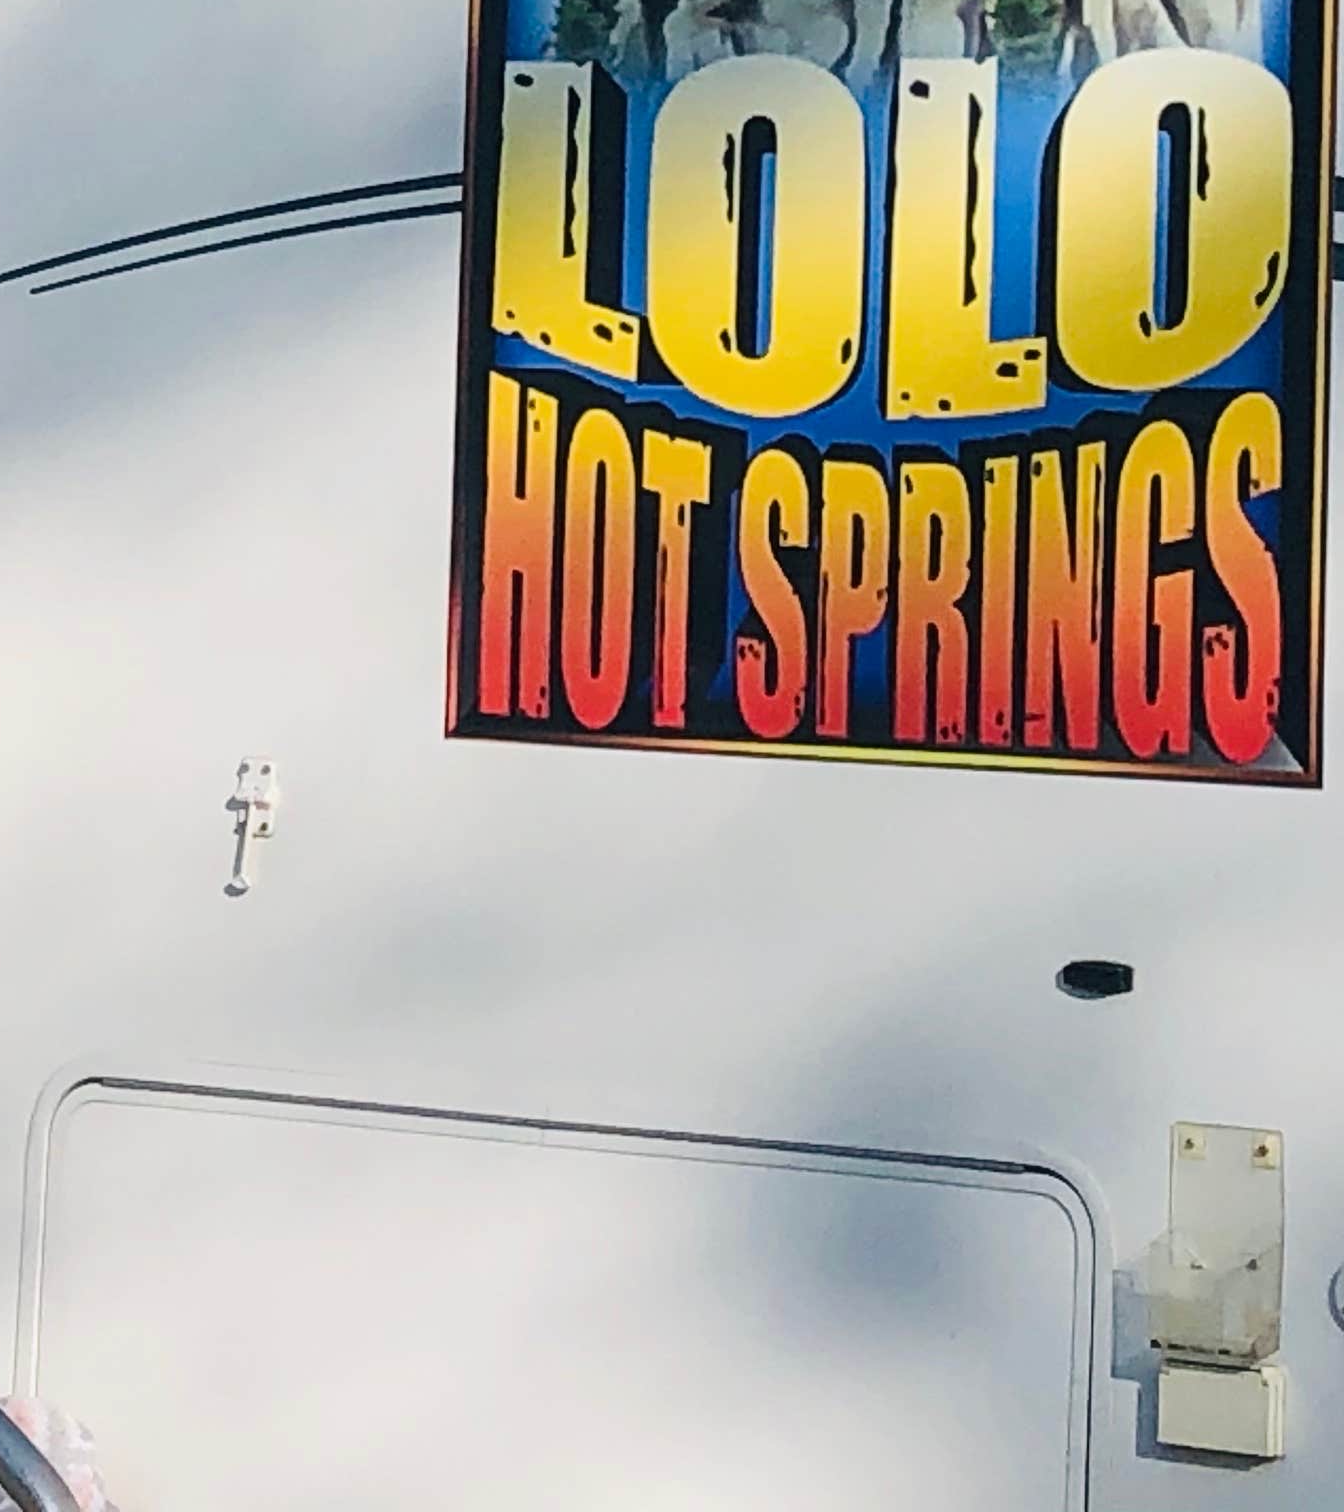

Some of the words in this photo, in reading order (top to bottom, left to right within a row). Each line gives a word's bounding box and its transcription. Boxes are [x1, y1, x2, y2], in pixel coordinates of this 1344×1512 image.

[490, 46, 1294, 421] LOLO
[478, 371, 711, 729] HOT
[736, 392, 1283, 764] SPRINGS
